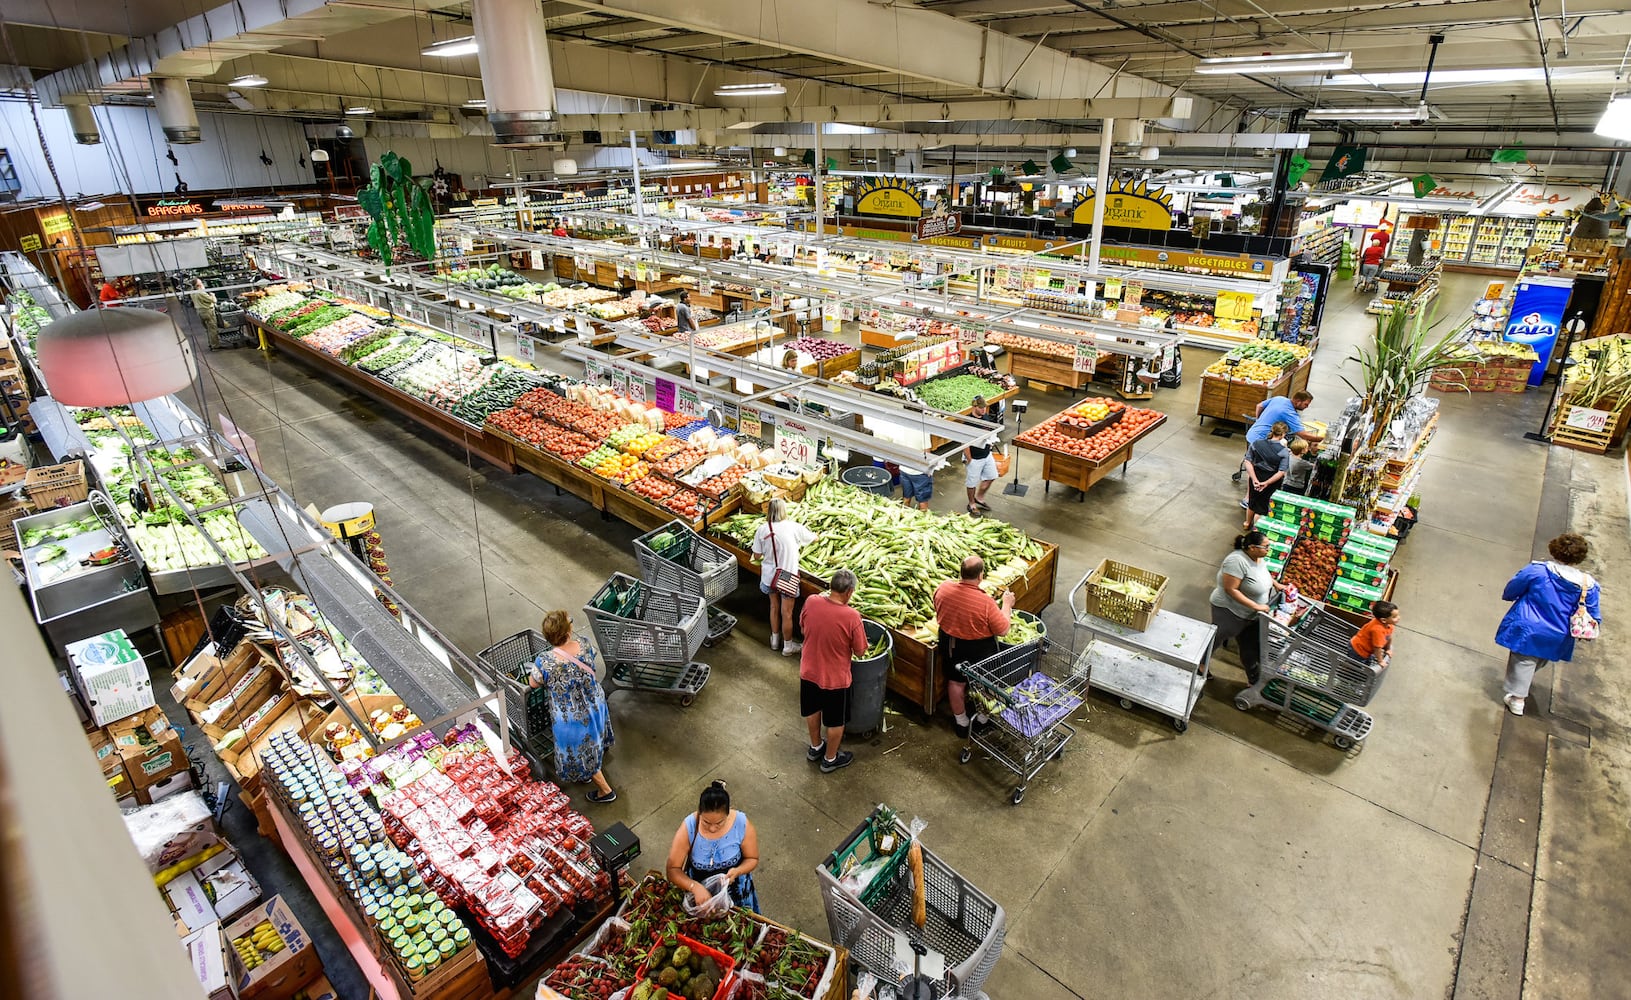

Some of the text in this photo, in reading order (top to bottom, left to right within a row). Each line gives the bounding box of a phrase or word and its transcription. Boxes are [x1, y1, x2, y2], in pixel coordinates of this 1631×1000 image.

[872, 197, 905, 209] Organic
[147, 204, 203, 216] BARGAINS
[1104, 204, 1147, 220] Organic
[856, 229, 900, 240] ORGANIC
[930, 237, 970, 248] VEGETABLES
[1002, 239, 1027, 248] FRUITS
[1075, 245, 1137, 259] OANIC
[1188, 256, 1248, 269] VEGETABLES
[1507, 324, 1554, 336] LALA
